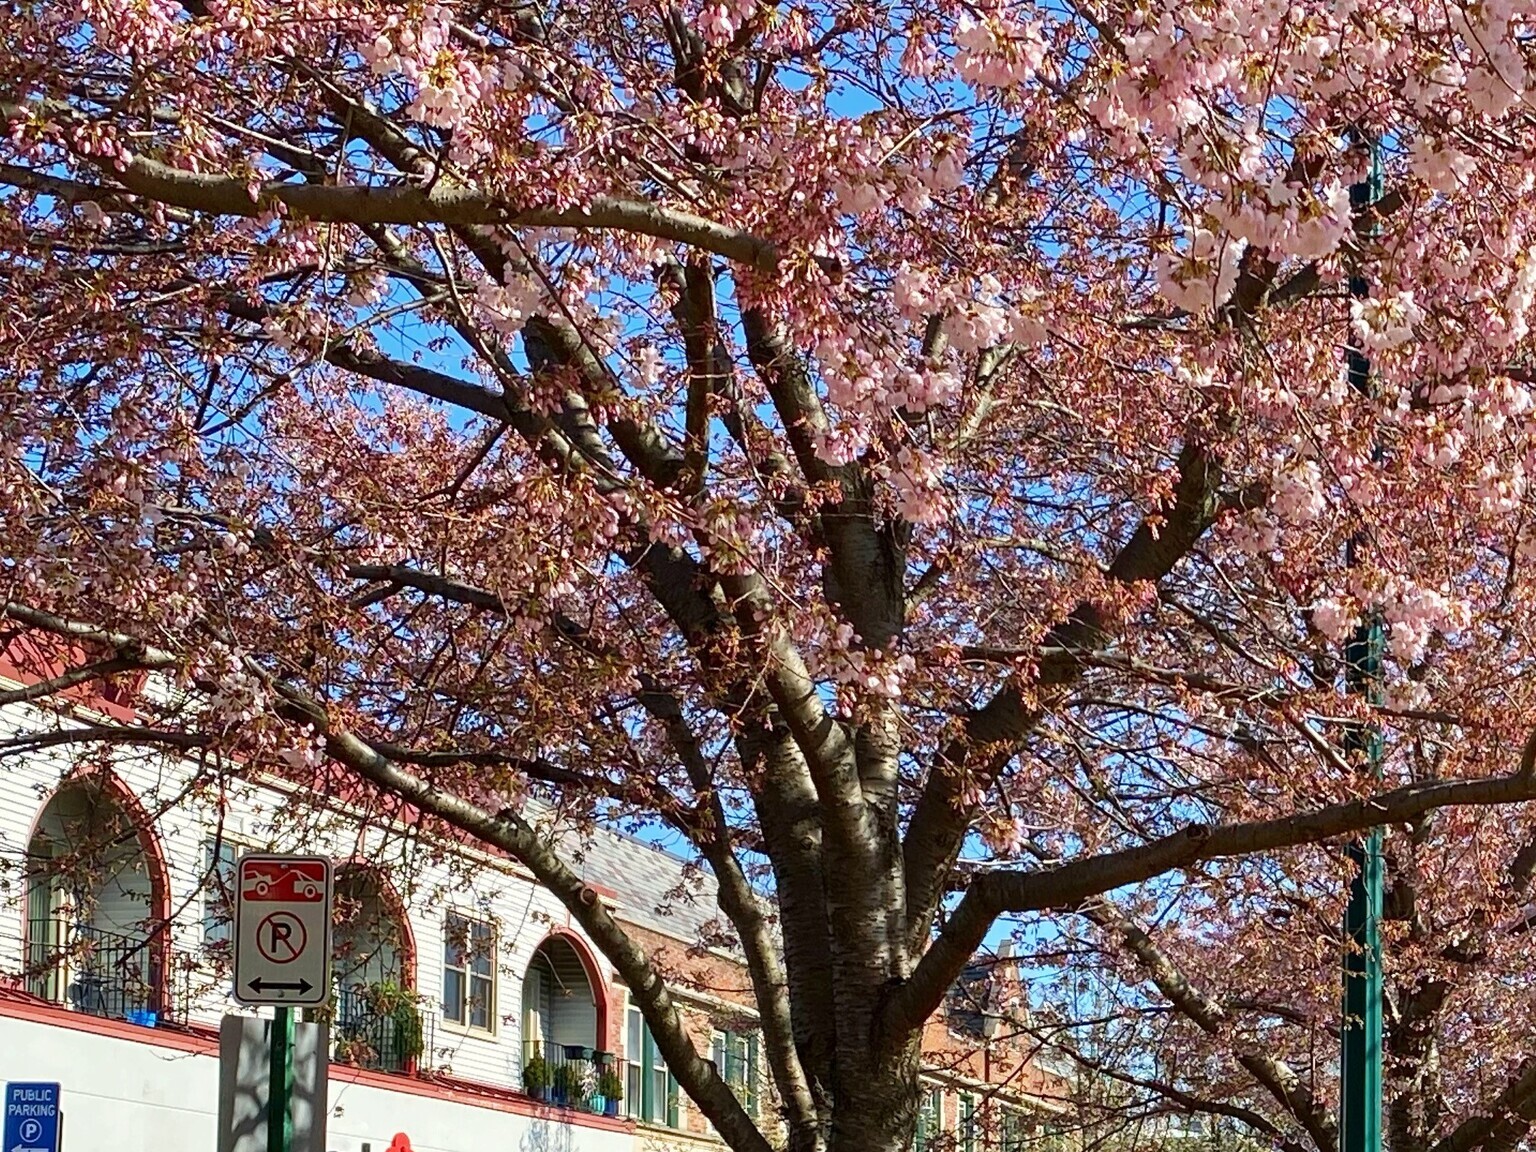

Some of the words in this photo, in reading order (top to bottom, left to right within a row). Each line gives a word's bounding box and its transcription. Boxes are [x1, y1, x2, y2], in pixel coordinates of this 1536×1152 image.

[271, 922, 292, 954] P
[13, 1088, 53, 1102] PUBLIC
[8, 1103, 56, 1117] PARKING
[25, 1123, 38, 1139] P
